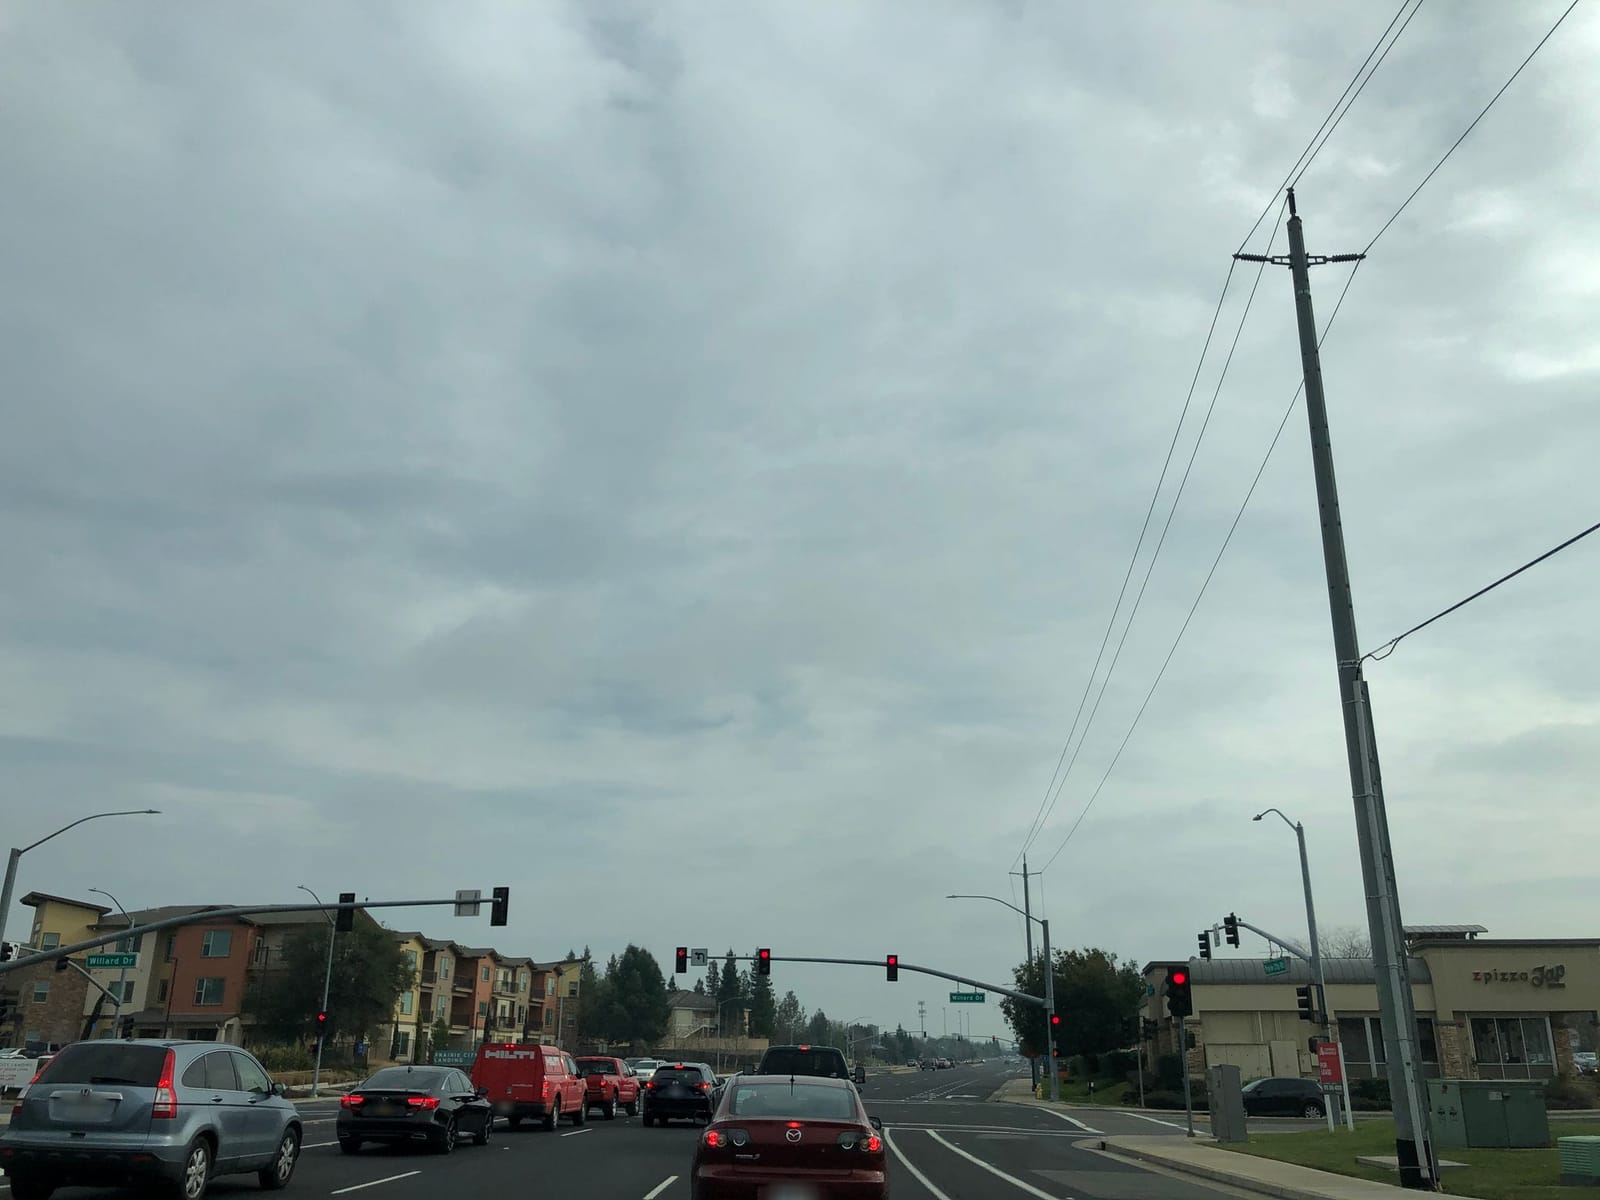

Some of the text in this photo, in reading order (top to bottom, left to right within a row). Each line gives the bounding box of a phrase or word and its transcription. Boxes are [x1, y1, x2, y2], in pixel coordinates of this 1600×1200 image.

[90, 956, 134, 965] Willard Dr
[485, 1050, 535, 1060] HILTI
